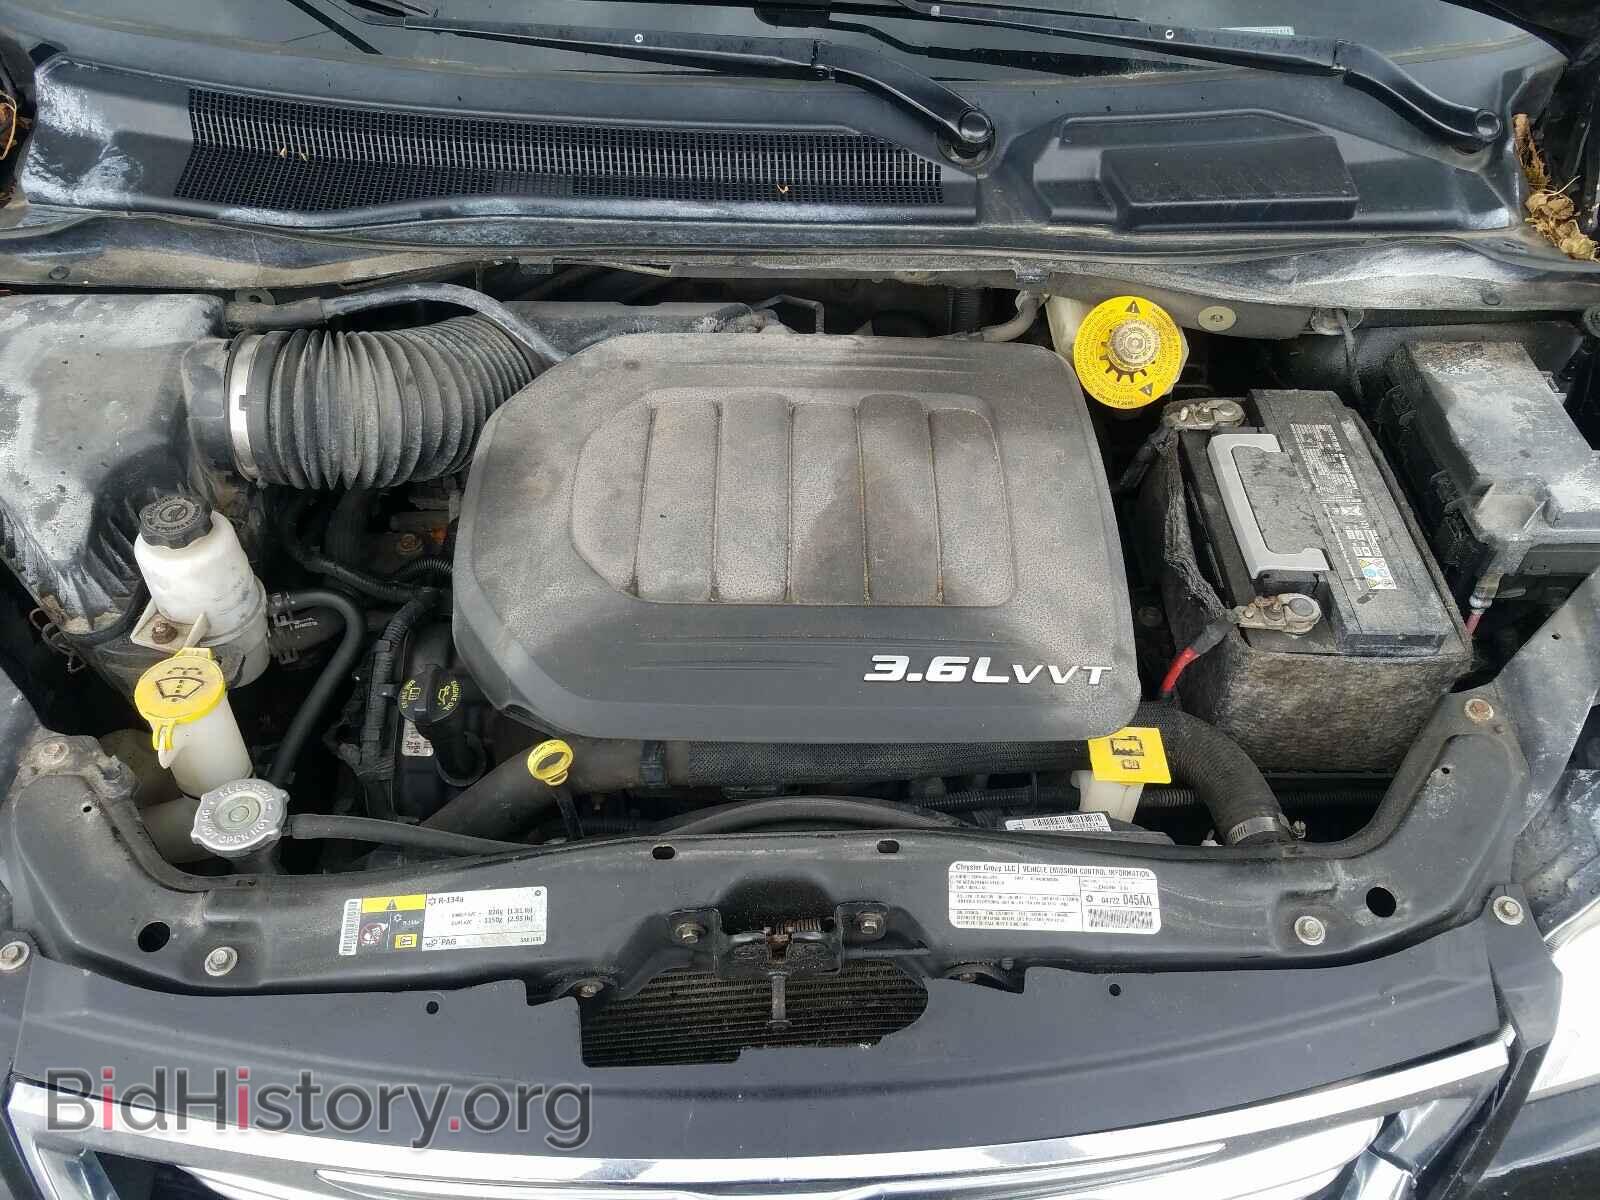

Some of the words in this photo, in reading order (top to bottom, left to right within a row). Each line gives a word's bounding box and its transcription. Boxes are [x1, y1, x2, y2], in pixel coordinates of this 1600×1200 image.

[863, 655, 1009, 683] 3.6L
[1011, 664, 1113, 685] VVT
[450, 680, 460, 702] ENGINE
[219, 833, 250, 844] OPEN
[1022, 865, 1048, 873] VEHICLE
[1049, 866, 1078, 874] EMISSION
[1108, 869, 1150, 878] INFORMATION
[438, 896, 464, 904] R-134a
